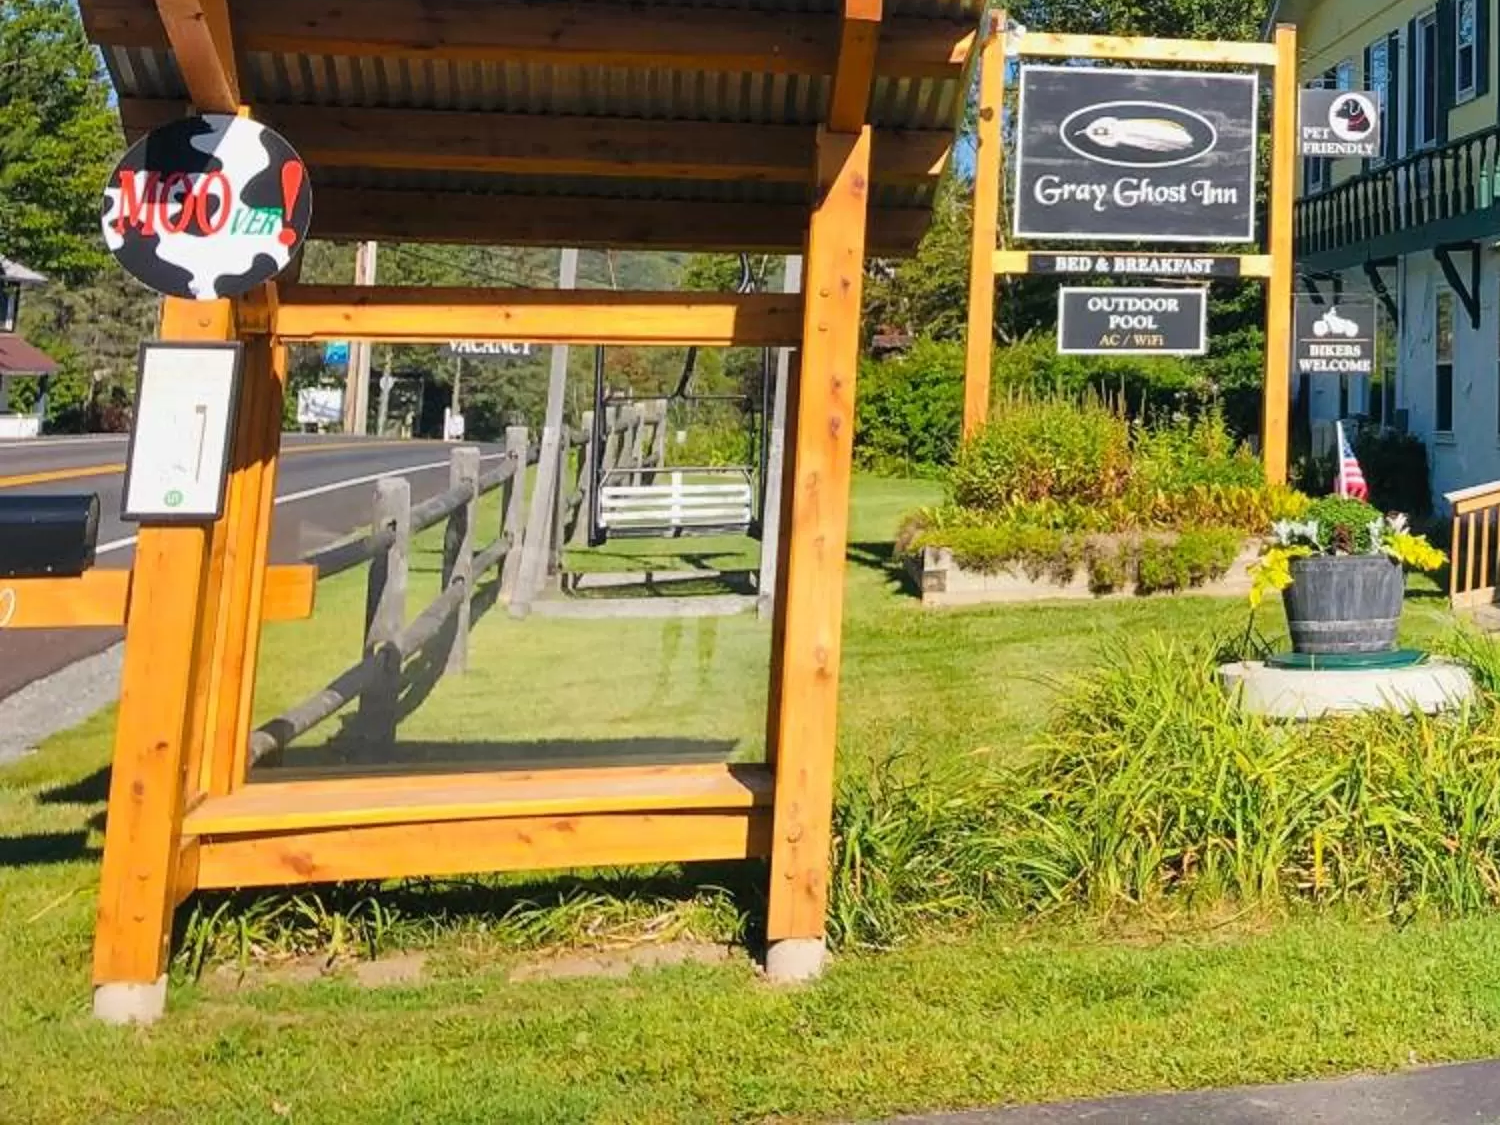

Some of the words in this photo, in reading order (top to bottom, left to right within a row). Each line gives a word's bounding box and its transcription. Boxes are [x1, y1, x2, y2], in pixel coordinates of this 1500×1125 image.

[1302, 126, 1330, 140] PET
[1302, 141, 1374, 155] FRIENDLY
[1033, 174, 1107, 212] Gray
[1112, 177, 1187, 207] Ghost
[1190, 179, 1238, 206] Inn
[1055, 256, 1093, 272] BED
[1095, 256, 1110, 273] &
[1113, 257, 1214, 274] BREAKFAST
[1087, 297, 1180, 313] OUTDOOR
[1108, 314, 1159, 330] POOL
[448, 340, 531, 355] VACANCY
[1099, 333, 1121, 347] AC
[1133, 333, 1165, 347] WiFi
[1309, 344, 1361, 357] BIKERS
[1298, 358, 1372, 373] WELCOME
